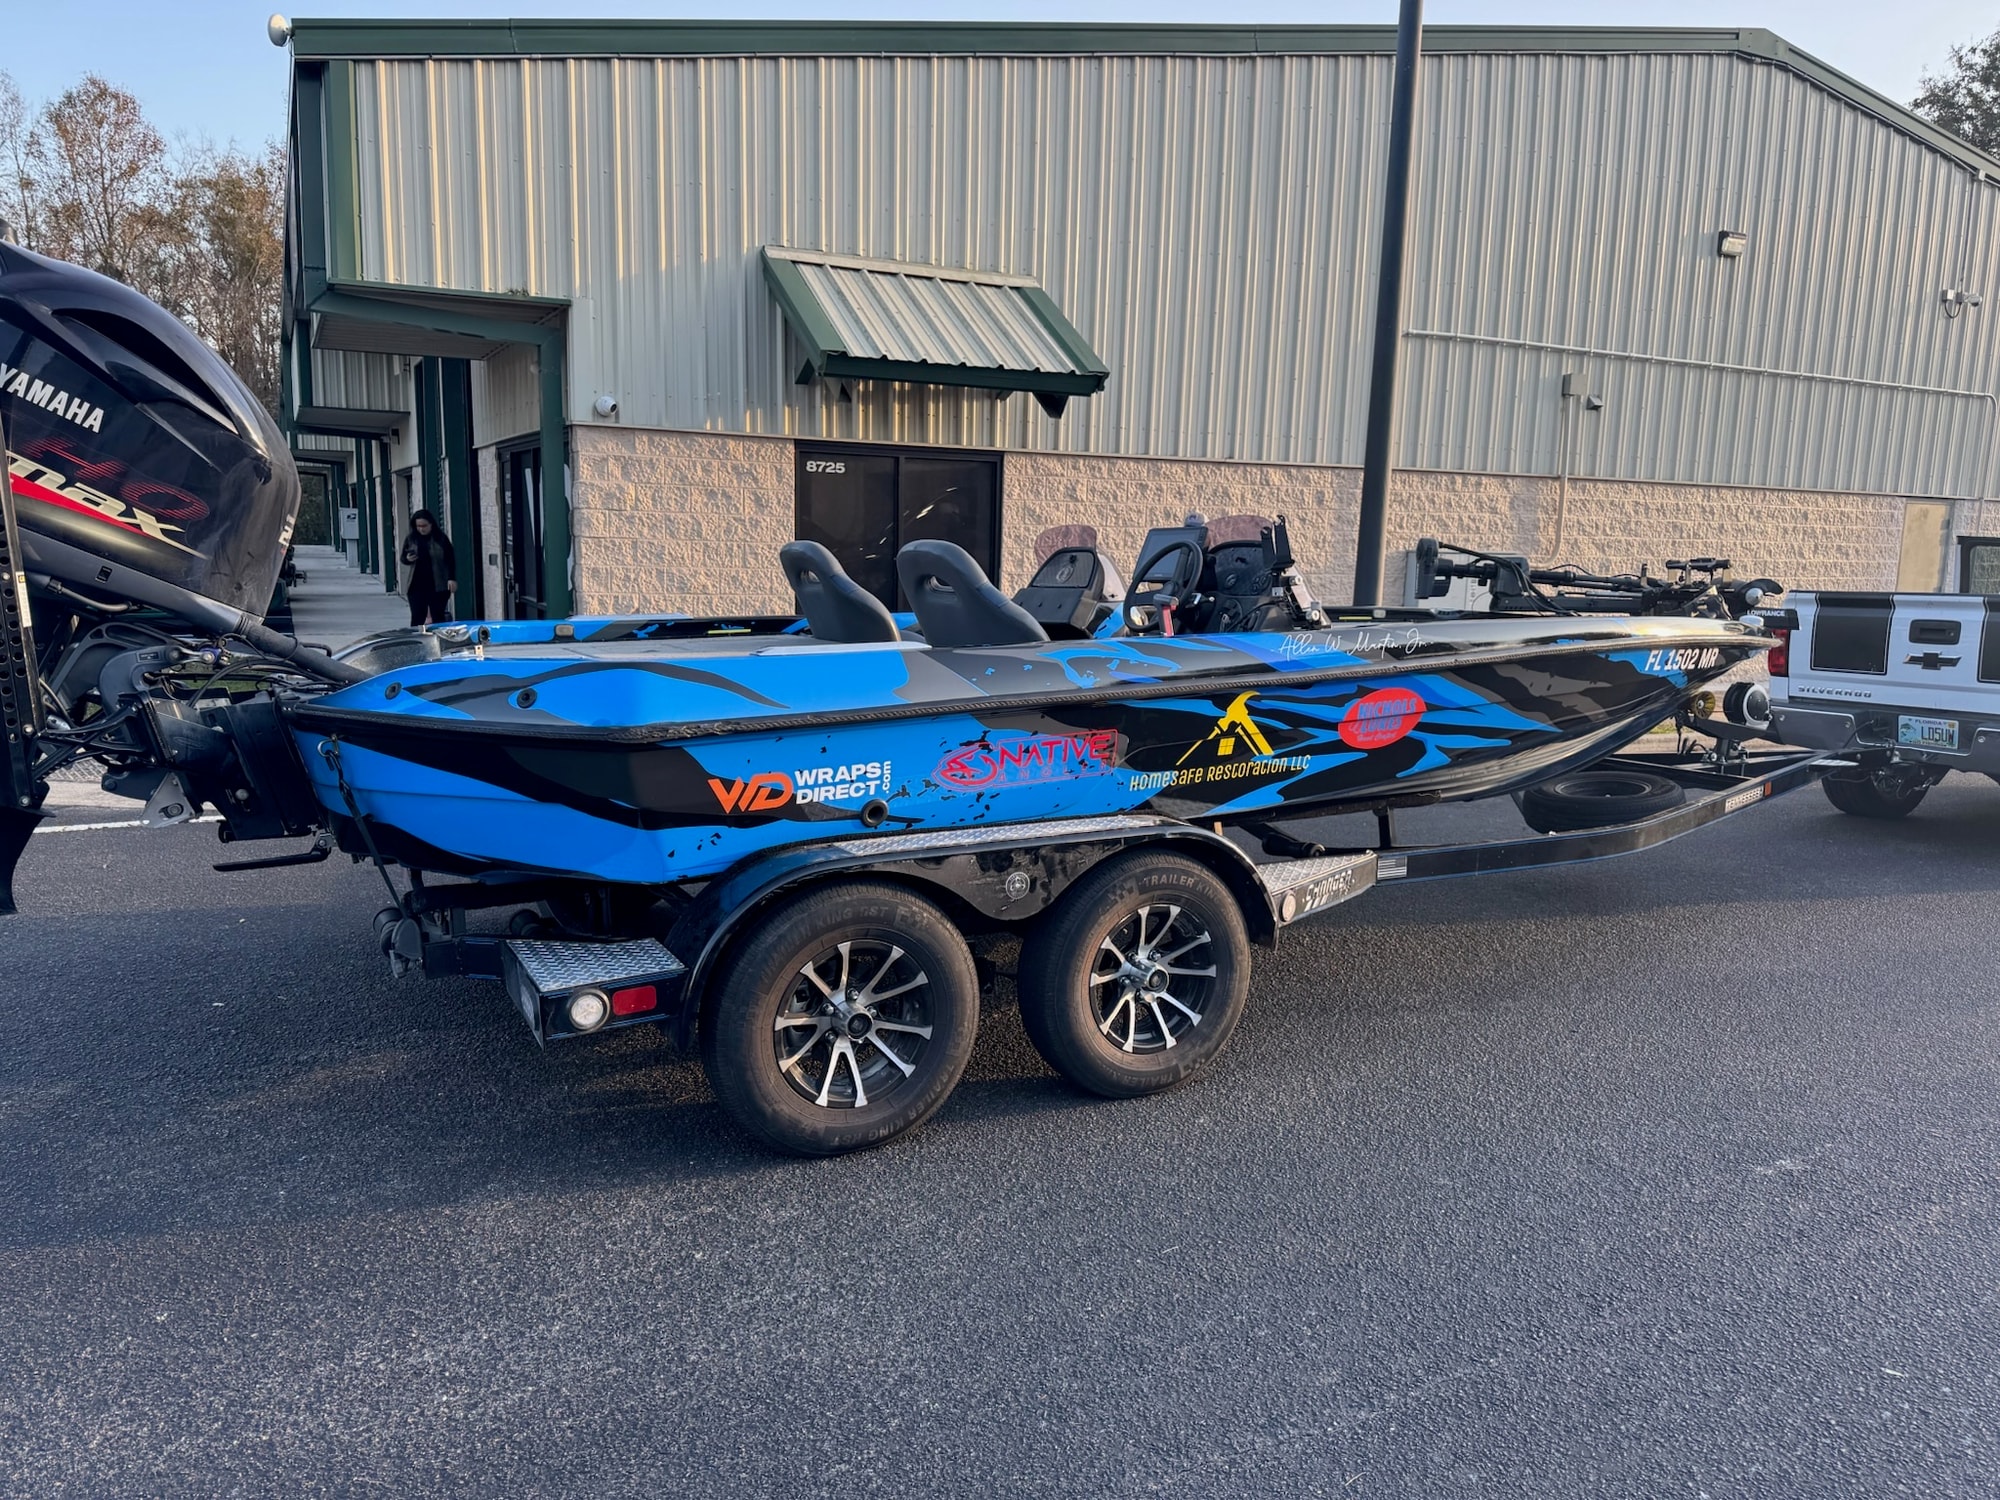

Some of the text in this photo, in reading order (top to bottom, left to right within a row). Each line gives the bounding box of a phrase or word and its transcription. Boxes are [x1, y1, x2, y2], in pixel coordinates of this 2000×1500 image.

[0, 363, 105, 433] YAMAHA
[805, 461, 846, 474] 8725
[1747, 609, 1786, 617] LOWRANCE
[1280, 633, 1320, 661] Allen
[1645, 648, 1720, 671] FL 1502 MR
[1798, 685, 1873, 699] SILVERADO
[1357, 697, 1418, 720] NICHOLS
[1914, 719, 1943, 727] FLORIDA
[1000, 734, 1112, 770] NATIVE
[1289, 754, 1312, 771] LLC
[794, 762, 882, 786] WRAPS
[795, 780, 881, 805] DIRECT
[1143, 874, 1195, 888] TRAILER
